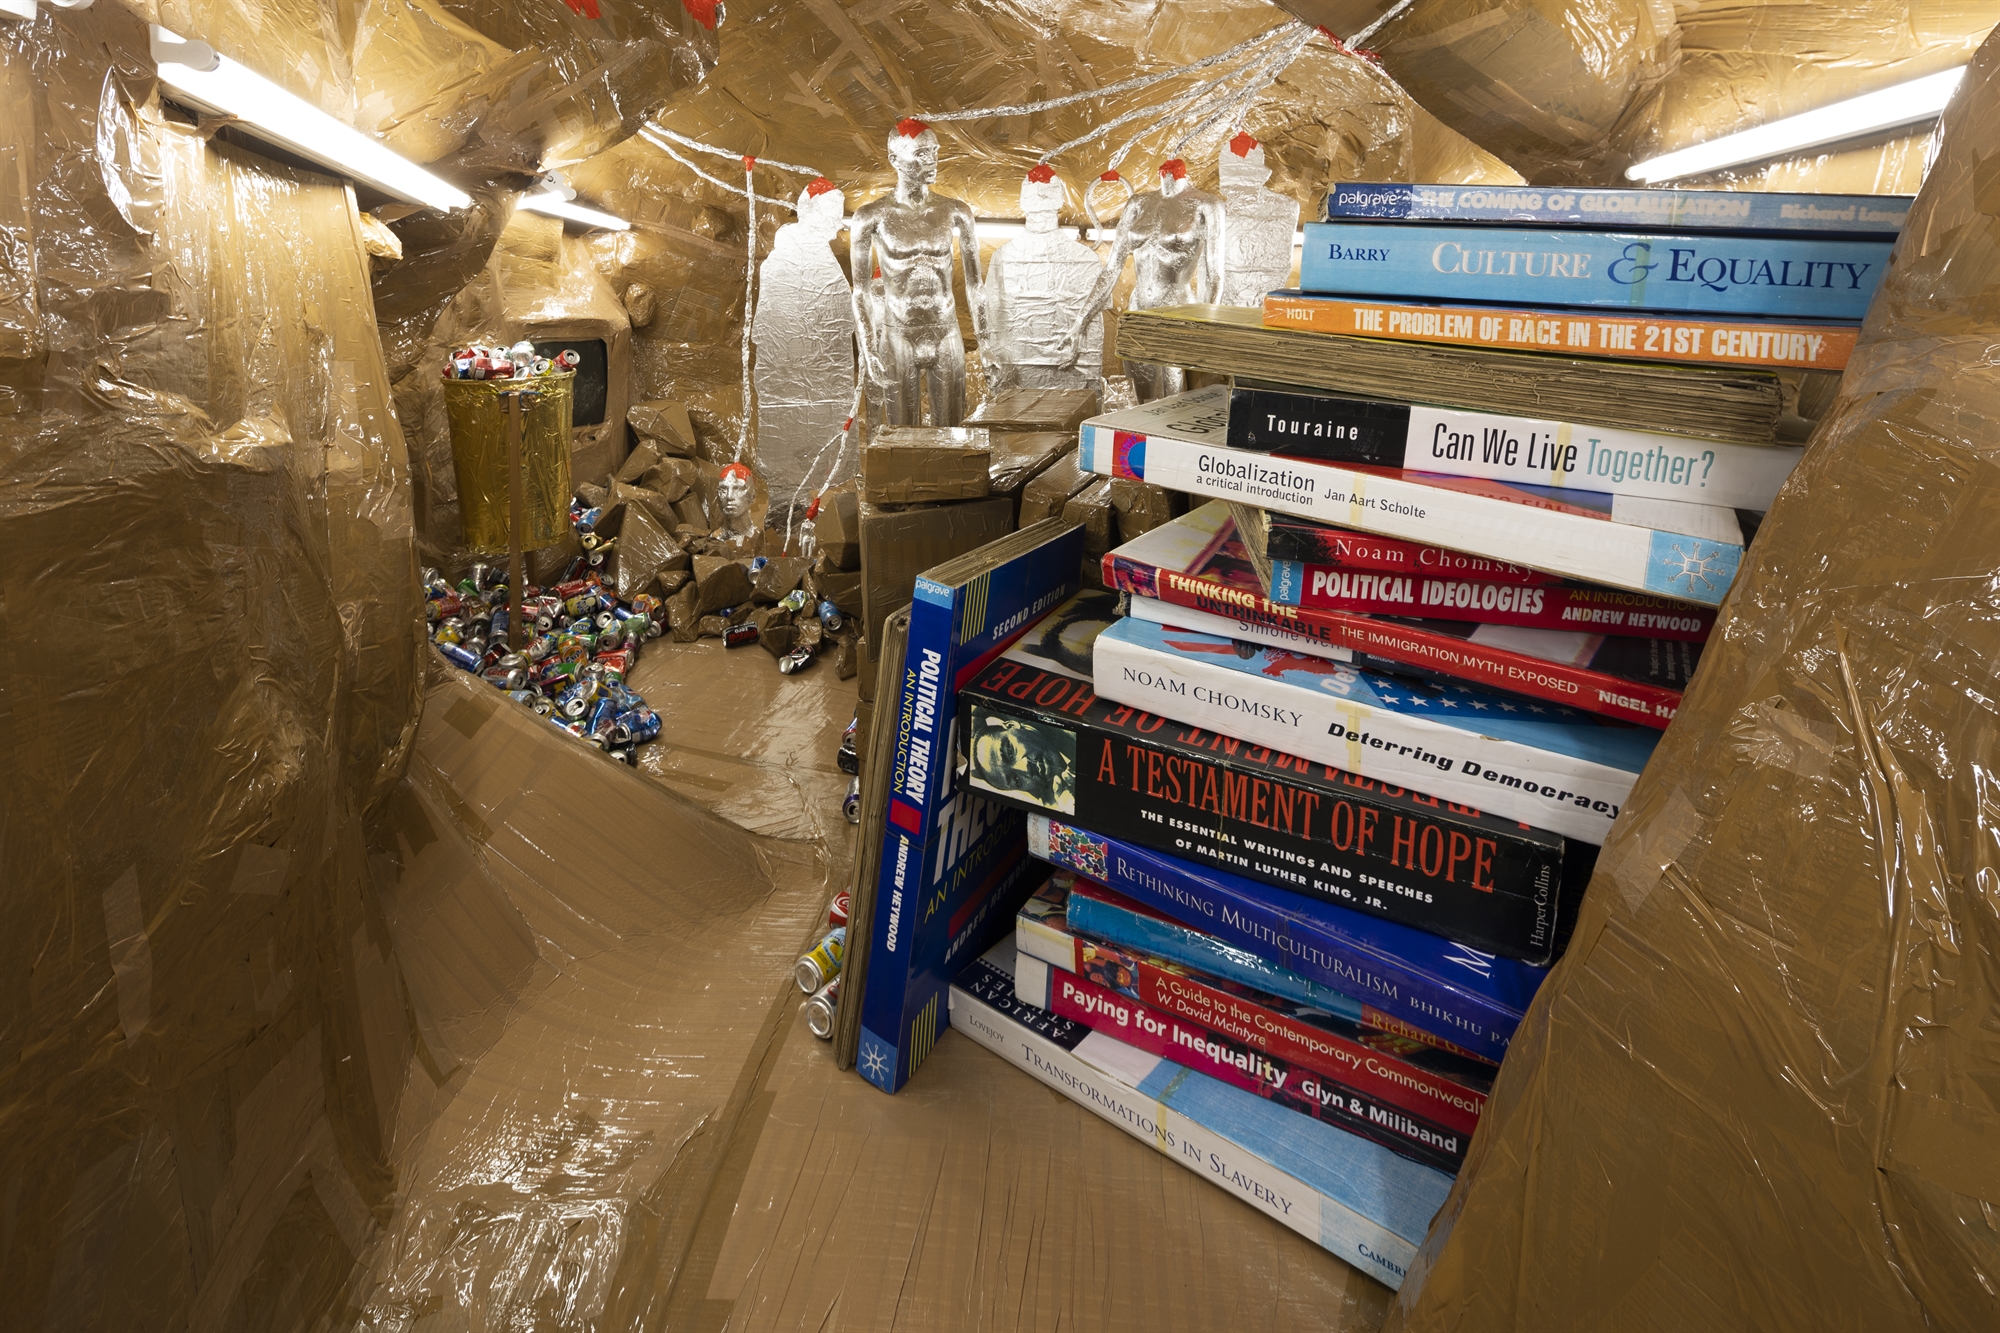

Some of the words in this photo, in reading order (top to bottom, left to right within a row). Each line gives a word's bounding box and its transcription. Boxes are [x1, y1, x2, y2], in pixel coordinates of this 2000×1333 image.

[1338, 191, 1397, 208] palgrave
[1420, 191, 1454, 207] THE
[1458, 191, 1543, 211] COMING
[1547, 194, 1575, 211] OF
[1579, 195, 1751, 217] GLOBALIZATION
[1781, 204, 1856, 221] Richard
[1328, 243, 1391, 262] BARRY
[1431, 242, 1593, 279] CULTURE
[1607, 242, 1659, 285] &
[1665, 248, 1872, 292] EQUALITY
[1286, 308, 1315, 321] HOLT
[1353, 308, 1384, 332] THE
[1388, 310, 1473, 339] PROBLEM
[1479, 316, 1503, 341] OF
[1508, 318, 1561, 345] RACE
[1567, 322, 1591, 347] IN
[1598, 323, 1637, 350] THE
[1644, 325, 1705, 355] 21ST
[1711, 329, 1823, 362] CENTURY
[1266, 414, 1359, 441] Touraine
[1432, 422, 1475, 461] Can
[1483, 427, 1519, 466] We
[1527, 433, 1578, 473] Live
[1586, 438, 1715, 488] Together?
[1196, 476, 1203, 484] a
[1205, 476, 1243, 492] critical
[1246, 483, 1313, 506] introduction
[1198, 454, 1315, 492] Globalization
[1324, 488, 1346, 502] Jan
[1349, 493, 1376, 509] Aart
[1379, 499, 1426, 519] Scholte
[915, 579, 950, 597] palgrave
[1278, 560, 1291, 601] palgrave
[1335, 539, 1404, 562] Noam
[1419, 548, 1533, 582] Chomsky
[992, 602, 1029, 641] SECOND
[1032, 585, 1066, 616] EDITION
[1196, 598, 1331, 641] UNTHINKABLE
[1312, 571, 1414, 604] POLITICAL
[1421, 580, 1545, 614] IDEOLOGIES
[1569, 590, 1590, 602] AN
[1594, 591, 1700, 612] INTRODUCTION
[1562, 606, 1625, 625] ANDREW
[1628, 612, 1702, 632] HEYWOOD
[1168, 574, 1255, 606] THINKING
[1262, 598, 1299, 619] THE
[1340, 626, 1365, 641] THE
[1368, 632, 1460, 664] IMMIGRATION
[1463, 656, 1505, 675] MYTH
[1508, 667, 1579, 694] EXPOSED
[1598, 690, 1651, 714] NIGEL
[905, 667, 917, 690] AN
[913, 648, 941, 733] POLITICAL
[980, 662, 1098, 717] HOPE
[893, 693, 917, 794] INTRODUCTION
[905, 736, 931, 806] THEORY
[1123, 667, 1187, 697] NOAM
[1193, 685, 1303, 728] CHOMSKY
[1327, 722, 1455, 772] Deterring
[1461, 760, 1620, 820] Democracy
[1096, 738, 1117, 786] A
[1126, 744, 1320, 841] TESTAMENT
[1331, 801, 1380, 857] OF
[1390, 815, 1497, 894] HOPE
[893, 834, 910, 890] ANDREW
[1140, 809, 1164, 824] THE
[1169, 817, 1238, 846] ESSENTIAL
[1243, 838, 1316, 869] WRITINGS
[1320, 862, 1352, 879] AND
[1358, 873, 1433, 904] SPEECHES
[1175, 838, 1193, 851] OF
[1196, 844, 1249, 868] MARTIN
[1254, 862, 1308, 886] LUTHER
[1313, 880, 1358, 902] KING,
[1364, 896, 1388, 911] JR.
[886, 889, 902, 953] HEYWOOD
[924, 881, 948, 924] AN
[1530, 864, 1551, 948] HarperCollins
[944, 903, 987, 965] ANDREW
[1117, 856, 1214, 918] RETHINKING
[1221, 904, 1399, 1000] MULTICULTURALISM
[1410, 996, 1482, 1036] BHIKHU
[970, 982, 1066, 1040] AFRICAN
[1155, 977, 1167, 990] A
[1170, 980, 1211, 1008] Guide
[1213, 997, 1227, 1014] to
[1229, 1003, 1252, 1024] the
[1254, 1014, 1362, 1068] Contemporary
[1156, 991, 1174, 1008] W.
[1176, 997, 1212, 1025] David
[1213, 1014, 1267, 1046] McIntyre
[1371, 1014, 1437, 1046] Richard
[1062, 981, 1130, 1027] Paying
[1135, 1009, 1168, 1038] for
[1173, 1024, 1288, 1089] Inequality
[1301, 1079, 1344, 1108] Glyn
[1349, 1097, 1365, 1116] &
[1369, 1105, 1457, 1154] Miliband
[969, 1015, 1005, 1043] LOVEJOY
[1021, 1043, 1176, 1147] TRANSFORMATIONS
[1182, 1140, 1203, 1163] IN
[1209, 1152, 1293, 1216] SLAVERY
